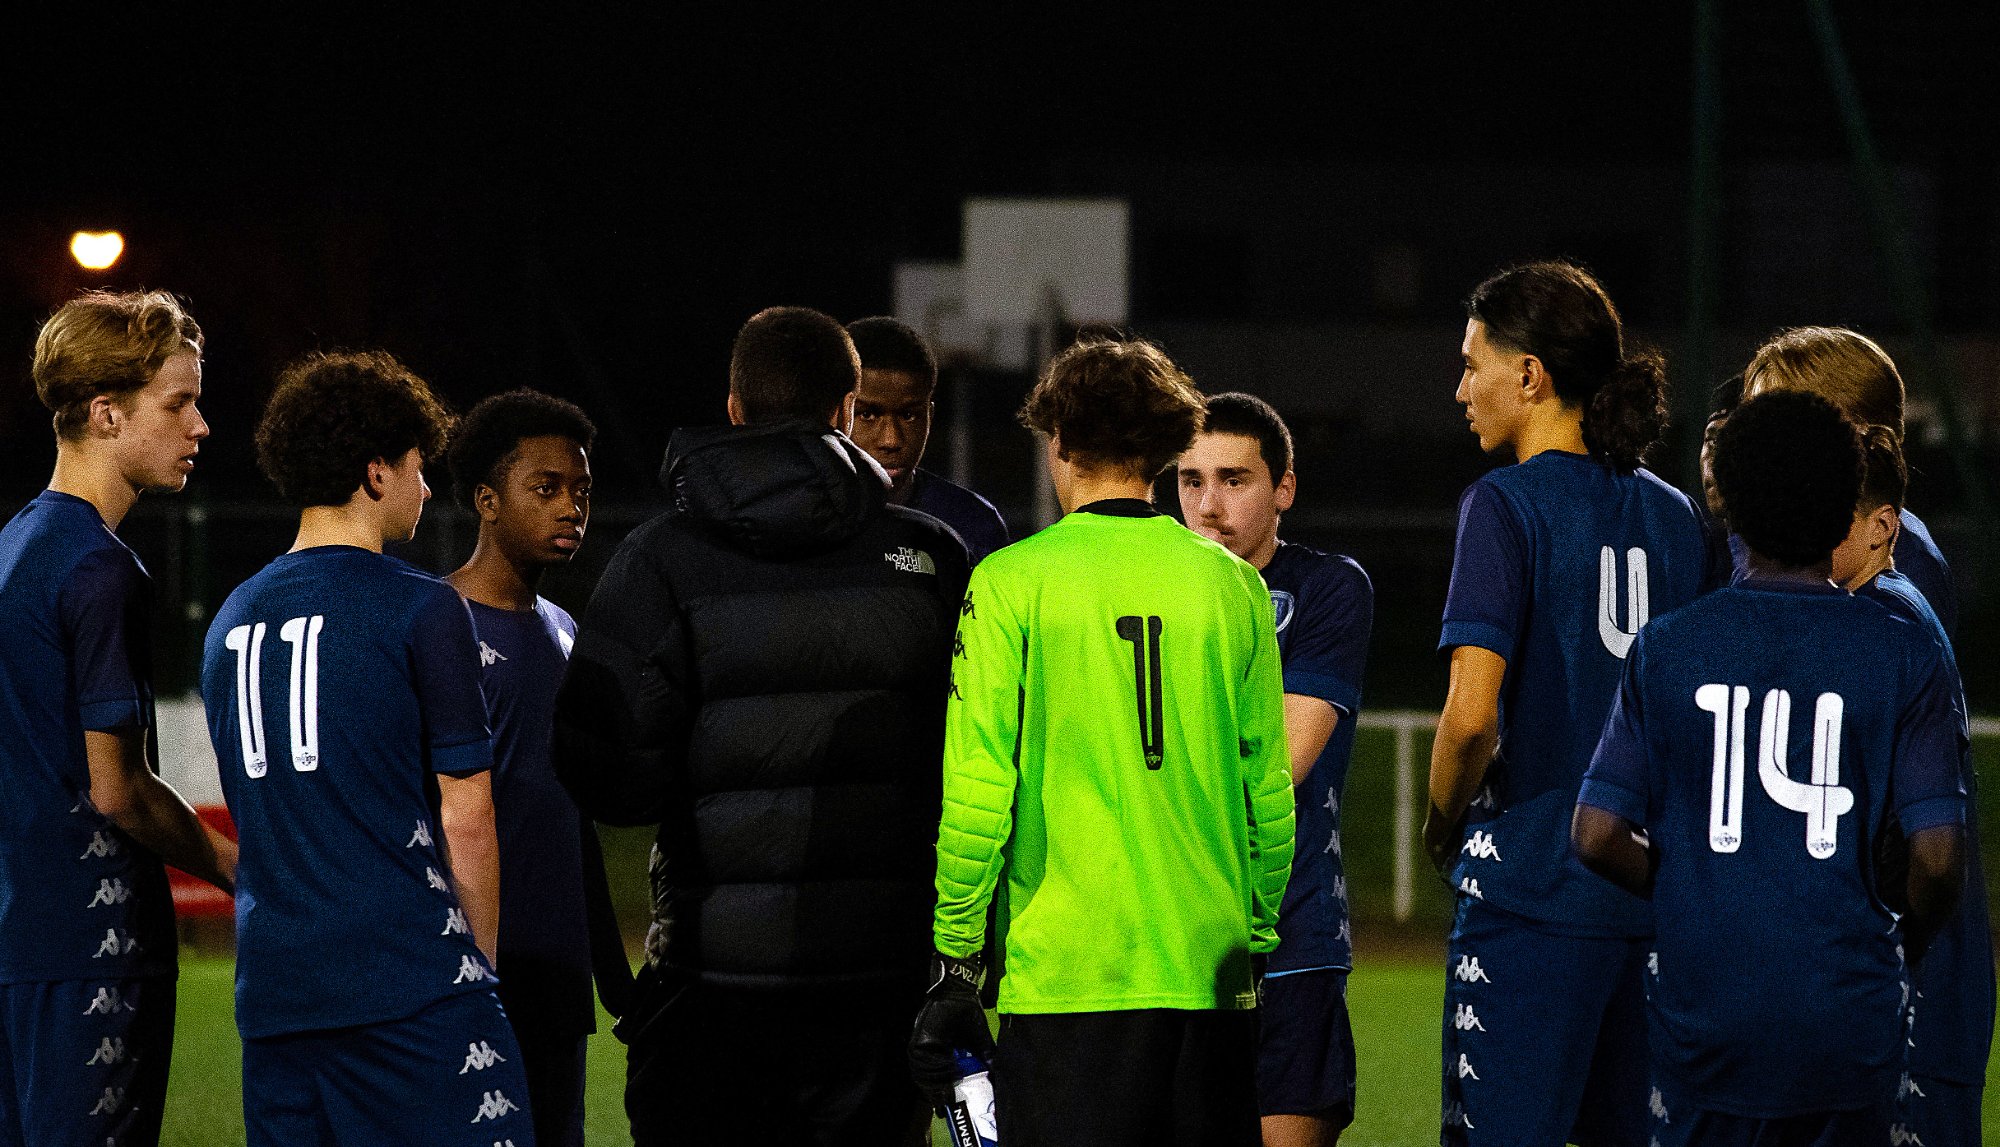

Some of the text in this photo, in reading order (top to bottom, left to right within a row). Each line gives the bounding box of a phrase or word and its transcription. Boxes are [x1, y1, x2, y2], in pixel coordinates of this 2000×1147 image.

[884, 552, 918, 566] NORTH
[895, 561, 919, 573] FACE
[897, 546, 914, 556] THE
[1598, 545, 1649, 659] 4
[225, 615, 324, 779] 11
[1115, 615, 1164, 771] 1
[1695, 683, 1854, 860] 14
